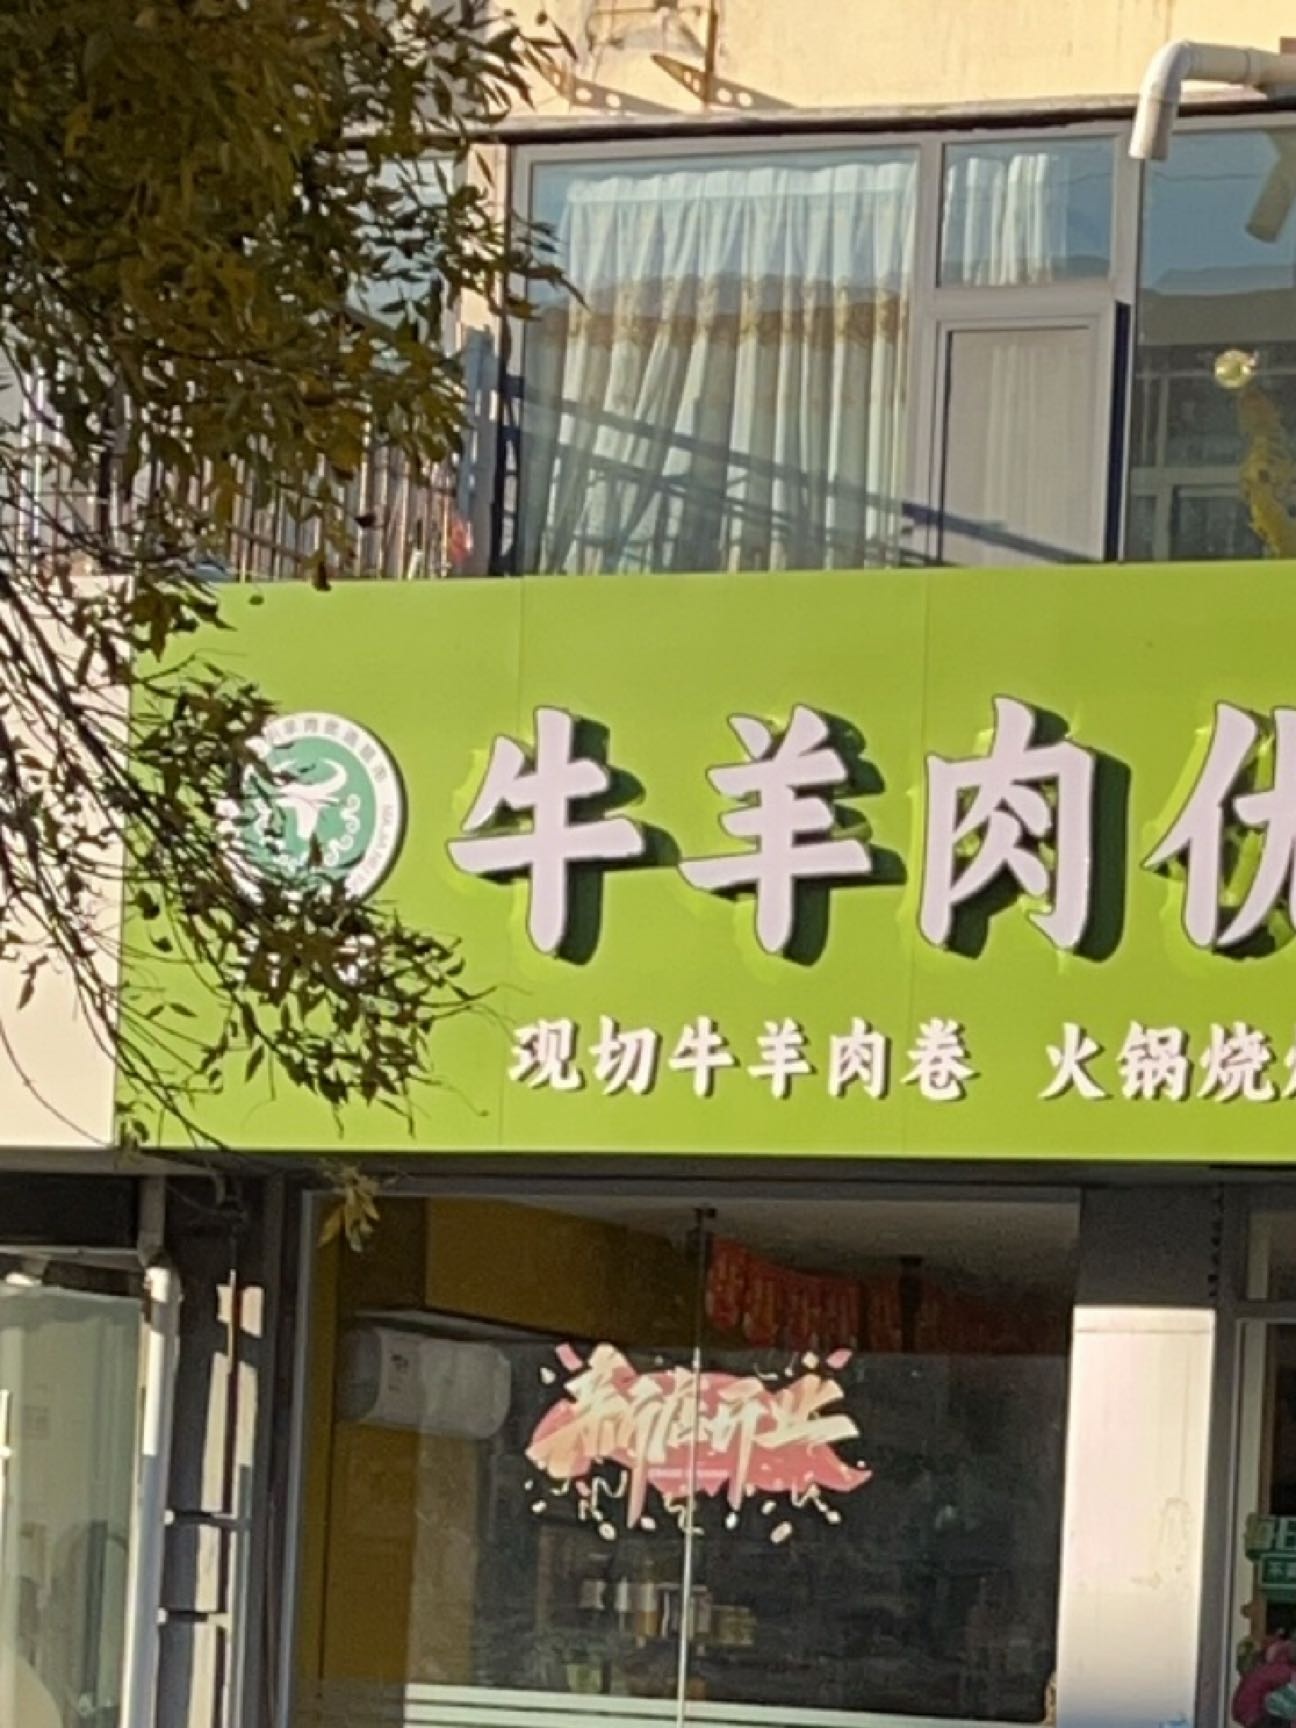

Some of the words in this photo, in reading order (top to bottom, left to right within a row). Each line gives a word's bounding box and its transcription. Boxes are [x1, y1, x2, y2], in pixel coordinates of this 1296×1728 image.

[506, 1015, 976, 1102] 现切牛羊肉卷
